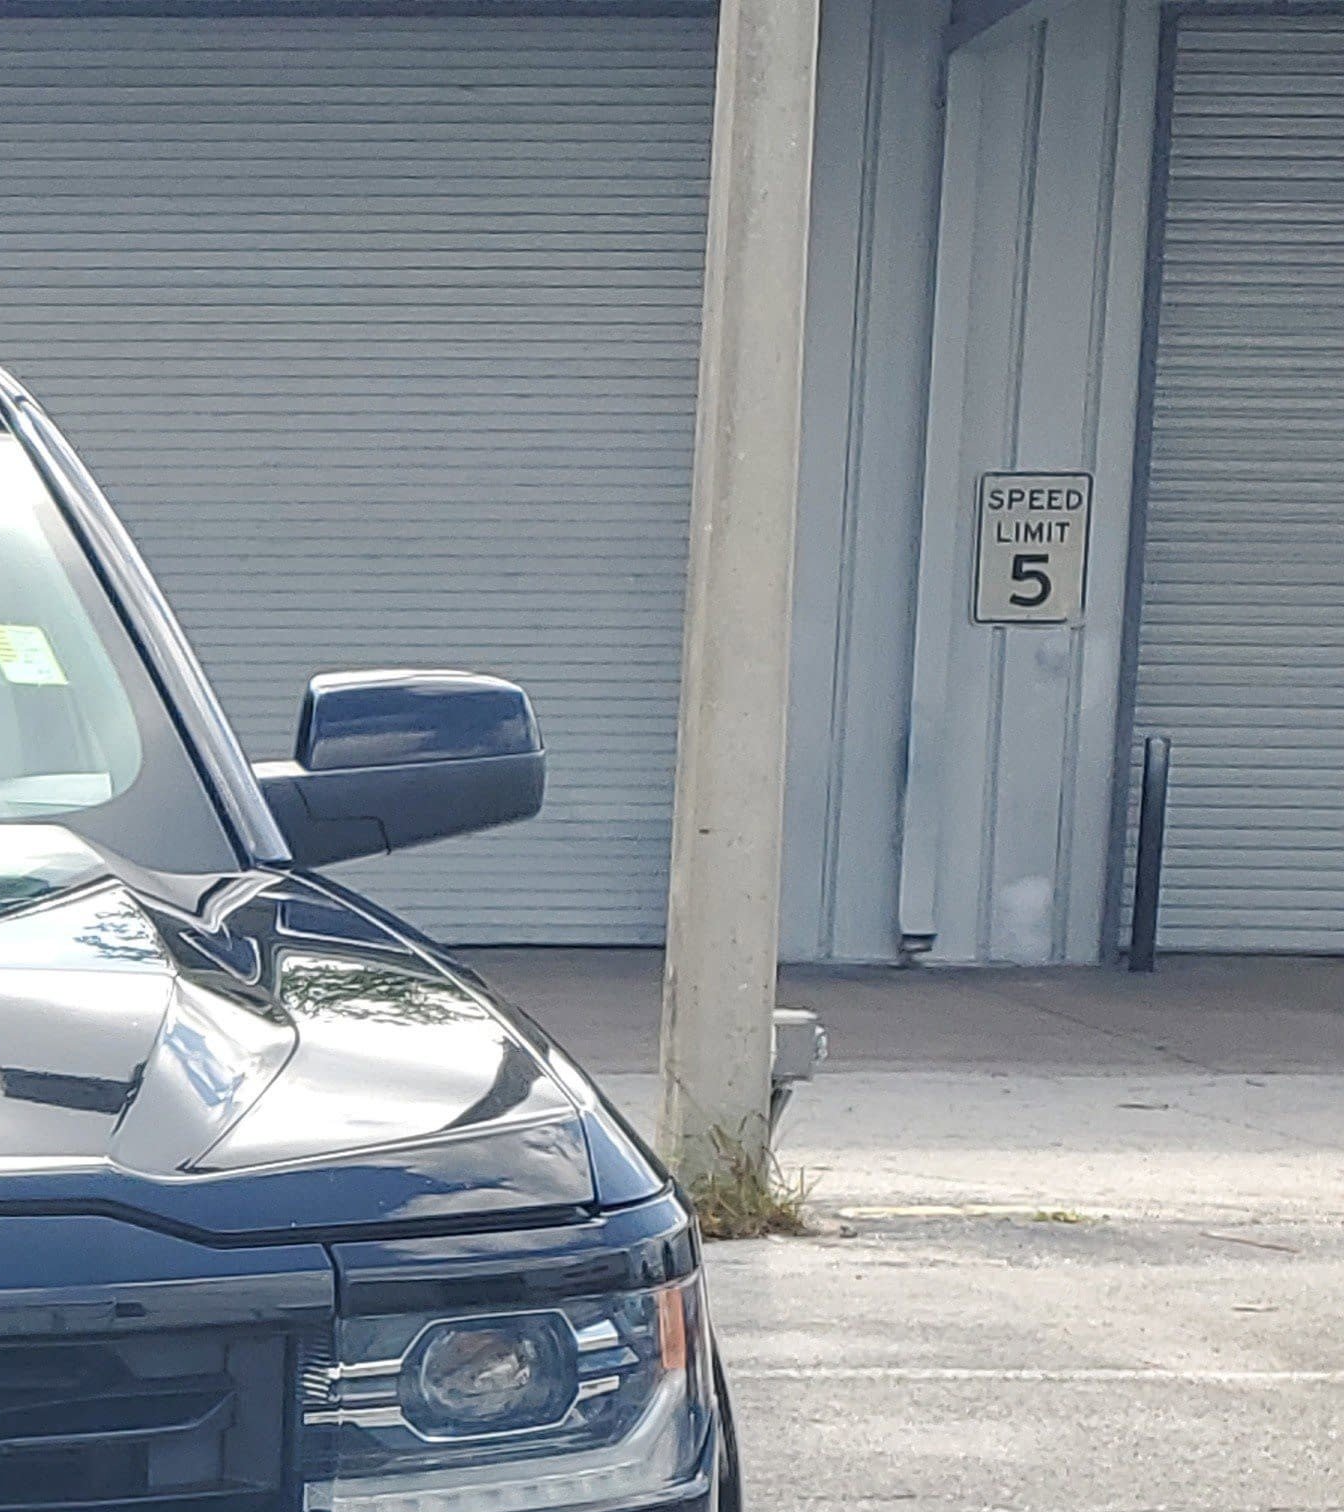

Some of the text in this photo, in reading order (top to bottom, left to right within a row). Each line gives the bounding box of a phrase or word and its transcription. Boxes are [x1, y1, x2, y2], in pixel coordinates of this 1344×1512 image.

[987, 488, 1083, 511] SPEED
[996, 521, 1070, 543] LIMIT
[1009, 553, 1052, 607] 5
